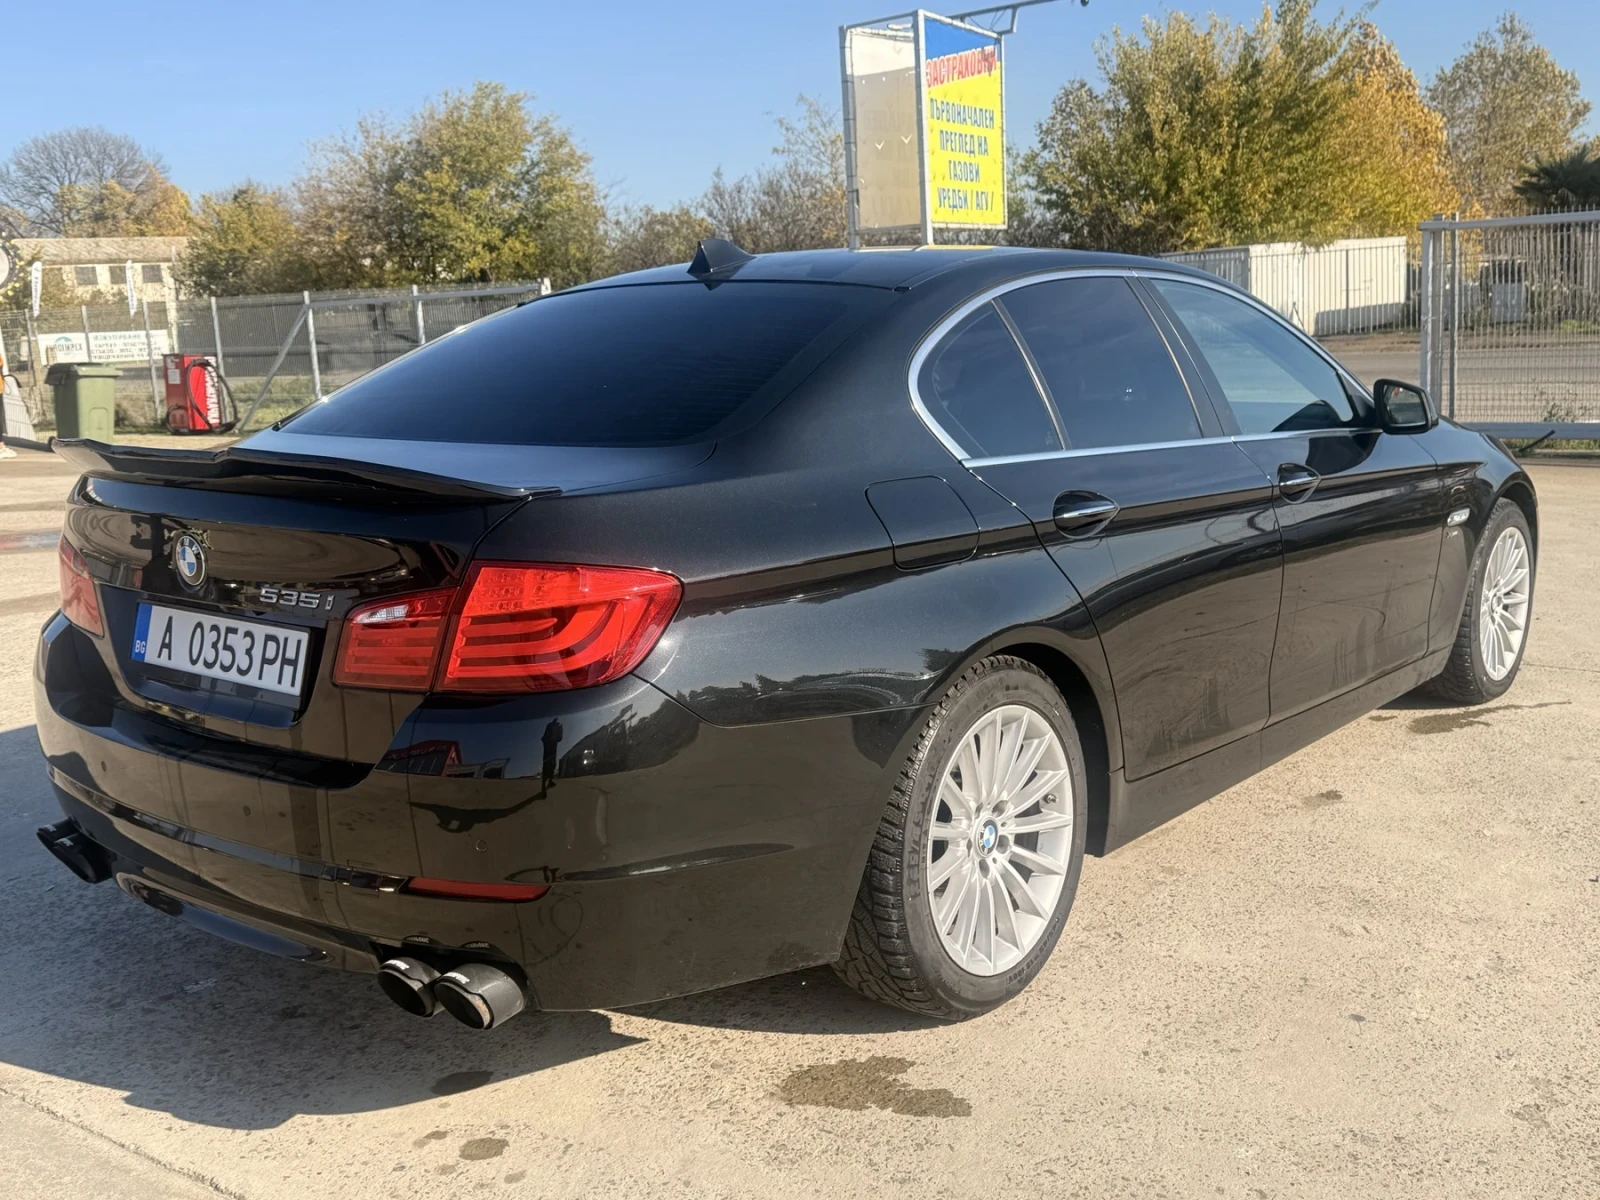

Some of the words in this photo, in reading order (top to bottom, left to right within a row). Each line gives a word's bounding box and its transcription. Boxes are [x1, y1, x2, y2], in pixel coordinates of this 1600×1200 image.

[930, 97, 994, 130] ПЪРВОНАЧАЛЕН
[939, 130, 976, 158] ПРЕГЛЕД
[977, 135, 989, 156] НА
[948, 160, 980, 183] ГАЗОВИ
[937, 187, 969, 212] УРЕДБИ
[259, 586, 335, 611] 535i
[135, 640, 146, 653] BG
[157, 616, 173, 661] A
